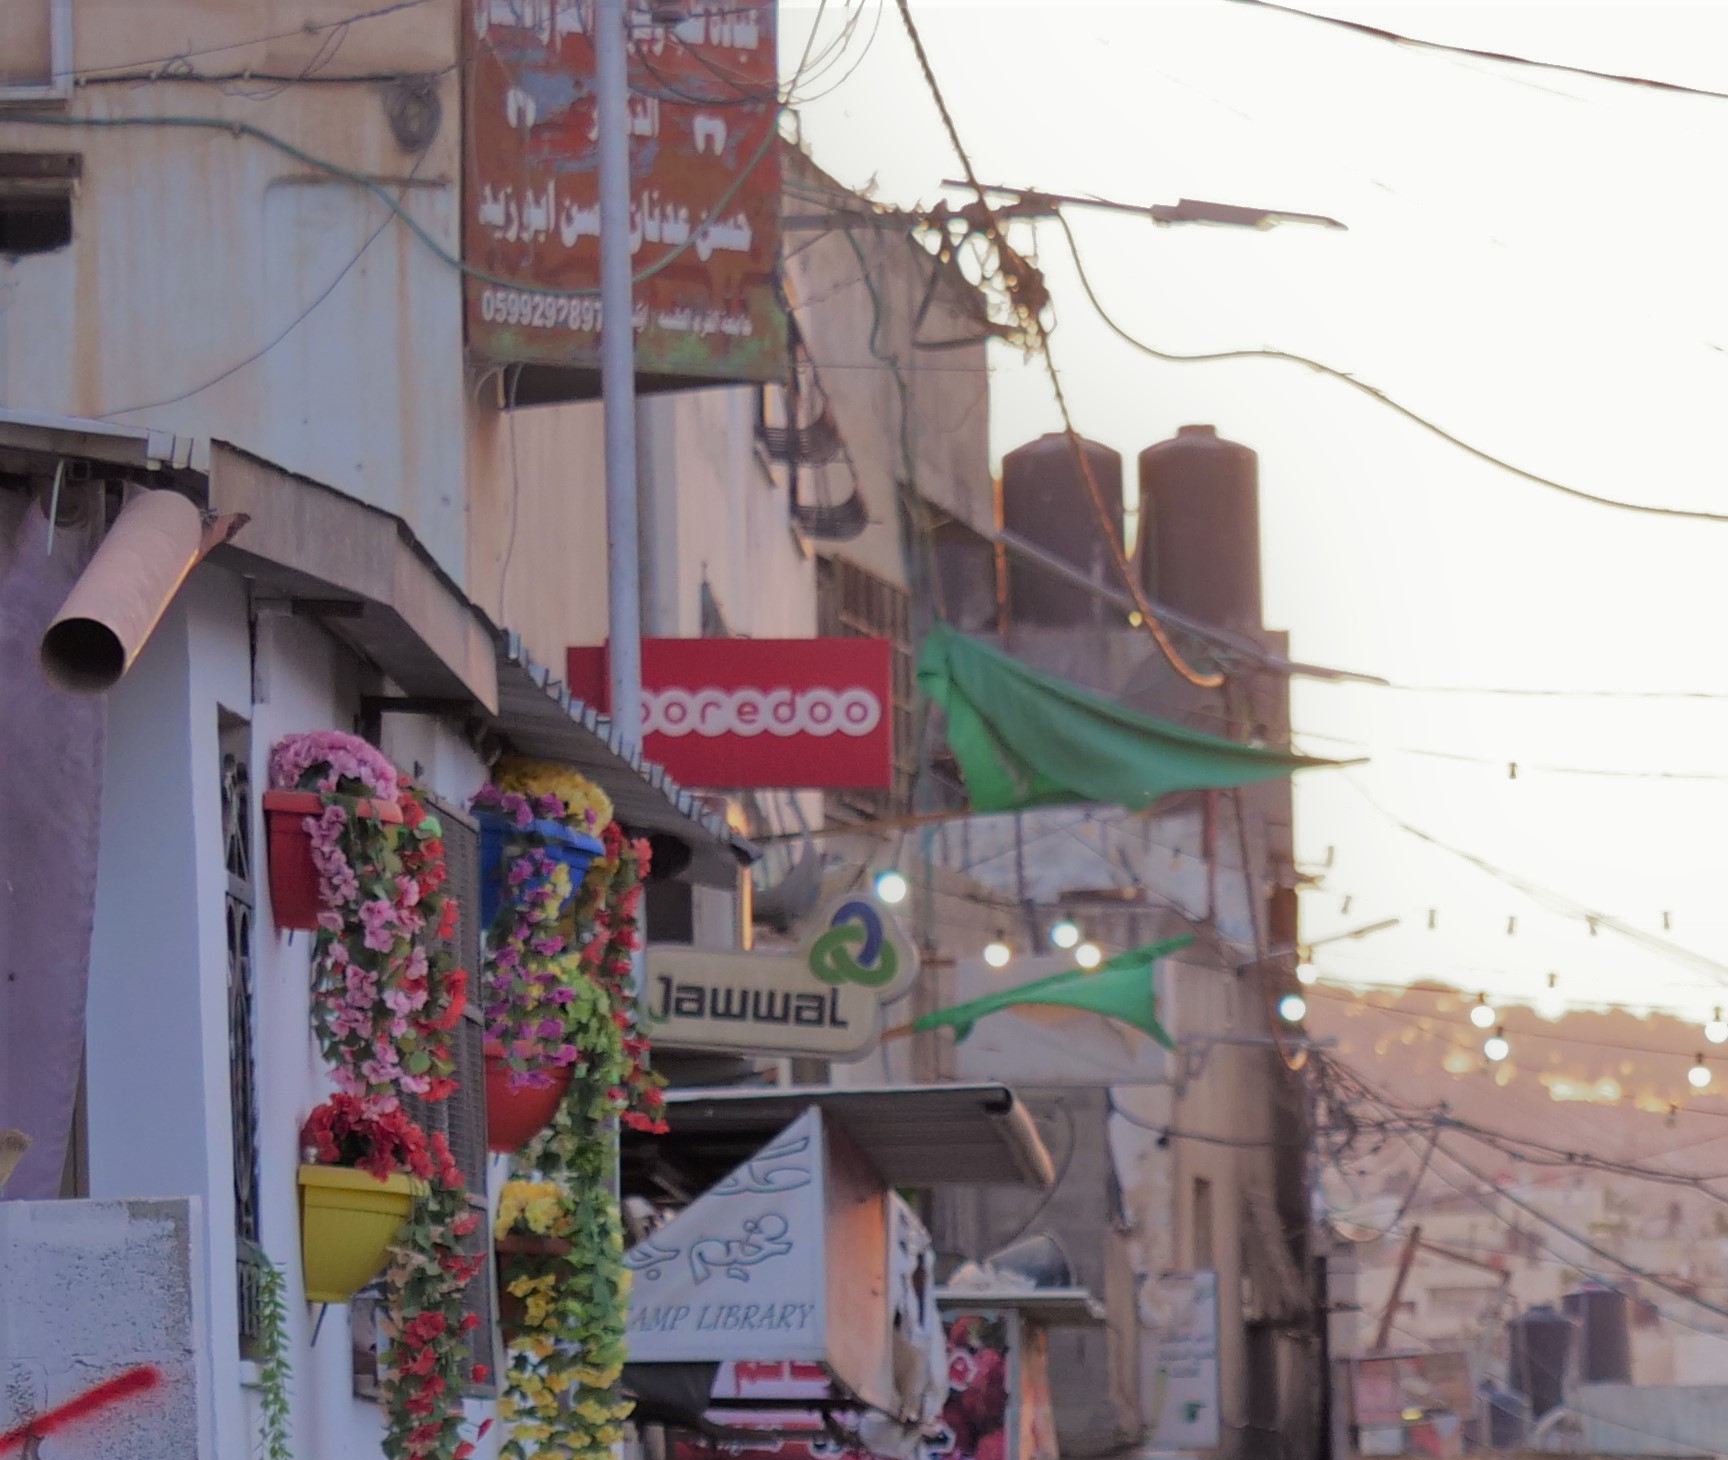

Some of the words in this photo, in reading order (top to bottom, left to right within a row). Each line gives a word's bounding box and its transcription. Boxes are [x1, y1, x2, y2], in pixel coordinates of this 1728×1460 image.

[649, 975, 849, 1030] Jawwal
[624, 1303, 691, 1333] AMP
[696, 1303, 815, 1332] LIBRARY
